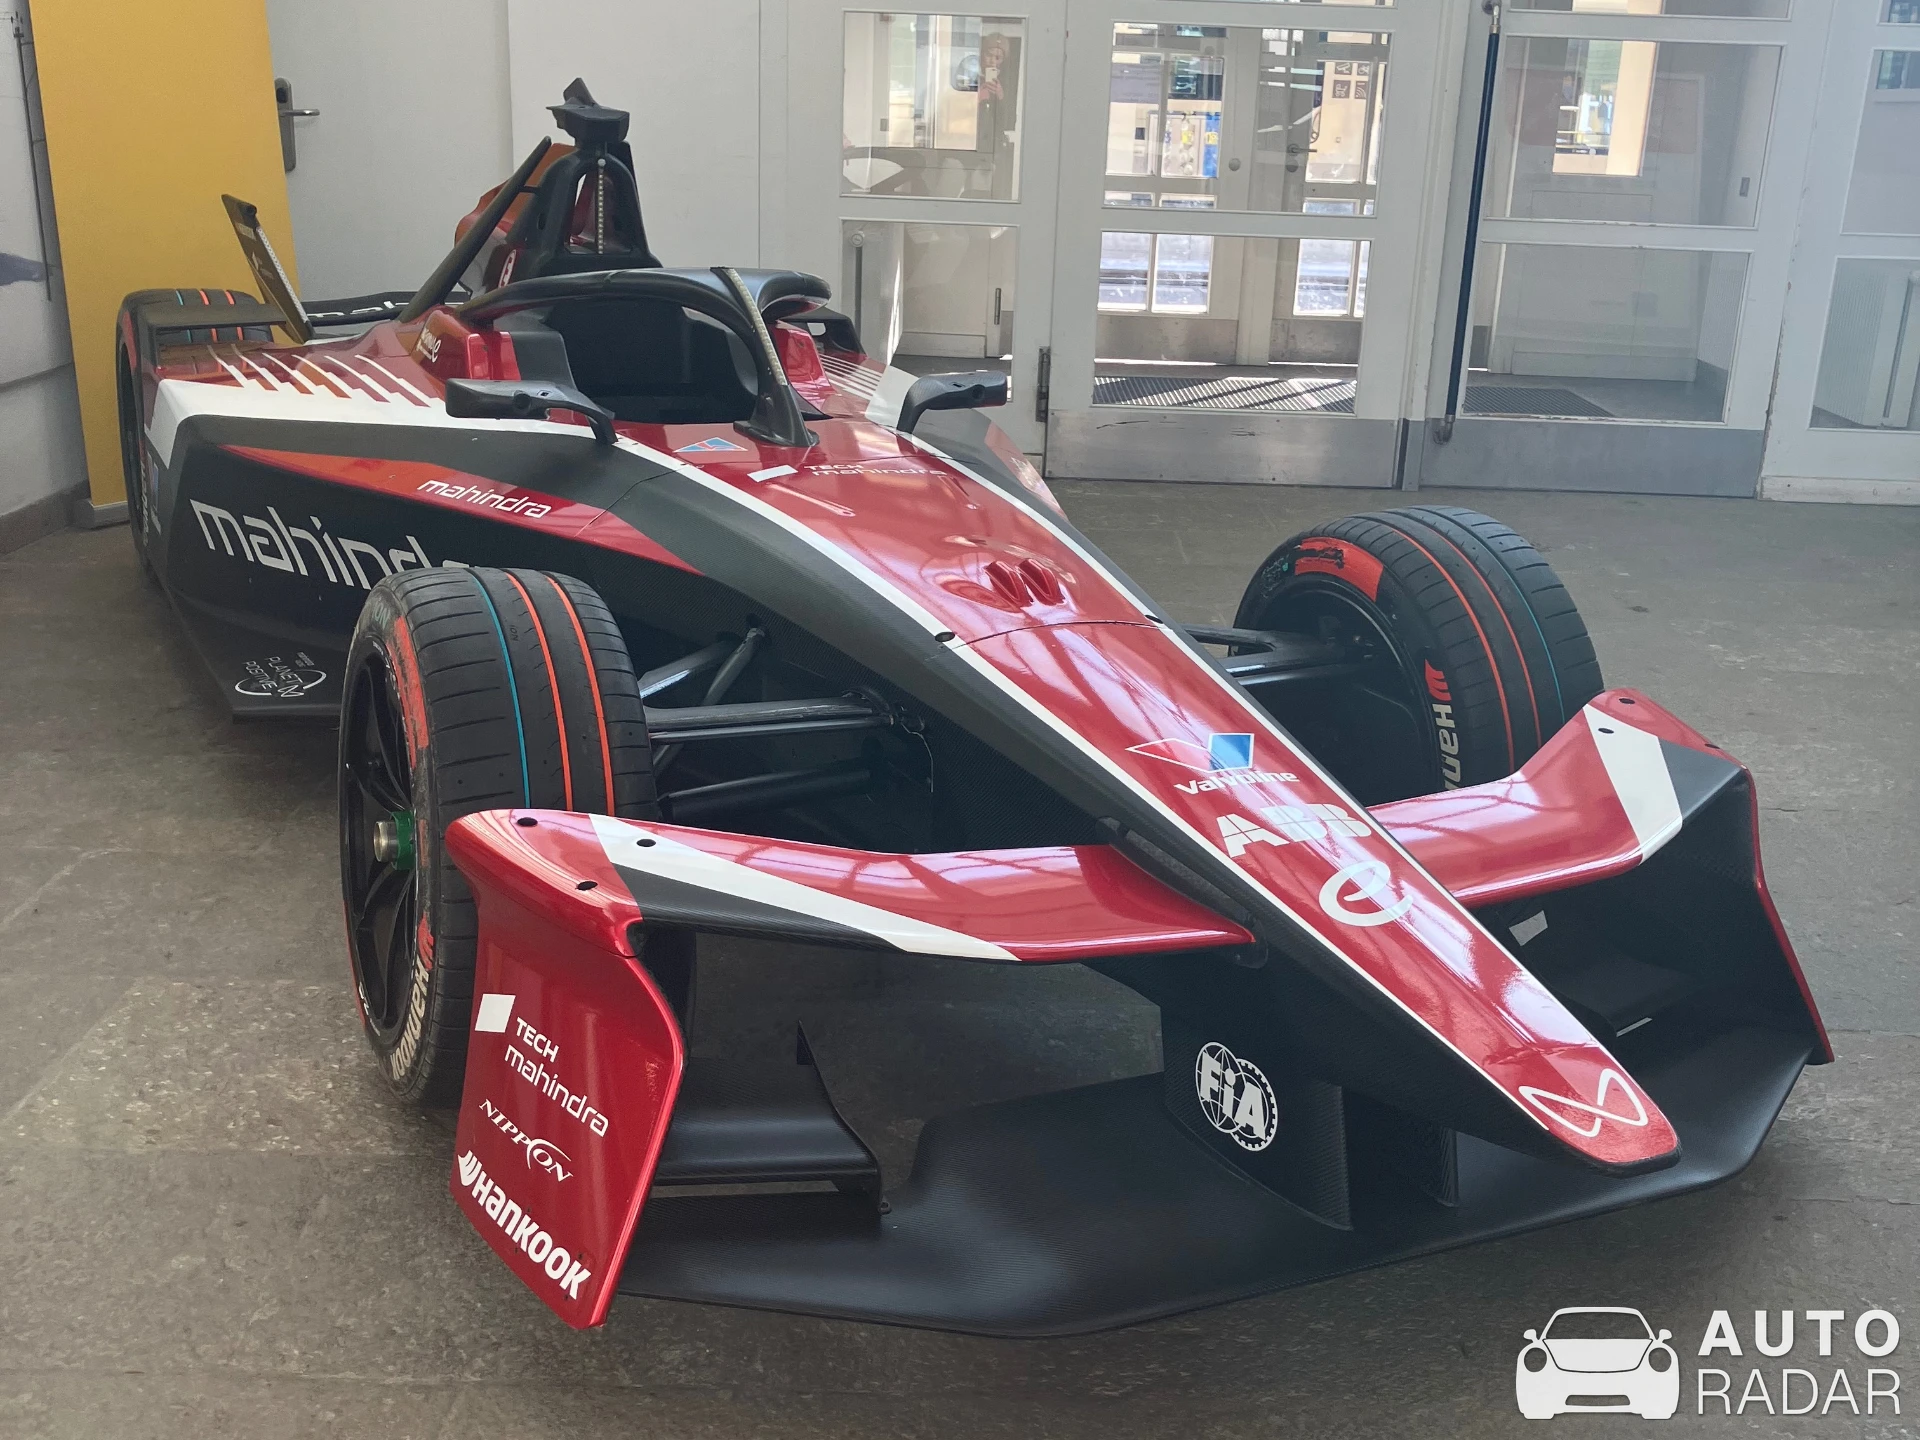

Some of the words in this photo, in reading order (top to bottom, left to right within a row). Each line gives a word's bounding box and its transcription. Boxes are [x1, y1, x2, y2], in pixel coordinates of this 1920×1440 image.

[417, 479, 552, 519] mahindra
[190, 499, 480, 590] mahin
[265, 656, 304, 684] PLANET
[1173, 770, 1300, 795] Valvoline
[1216, 803, 1372, 859] ABB
[516, 1016, 560, 1063] TECH
[504, 1044, 610, 1138] mahindra
[478, 1098, 574, 1182] NIPPON
